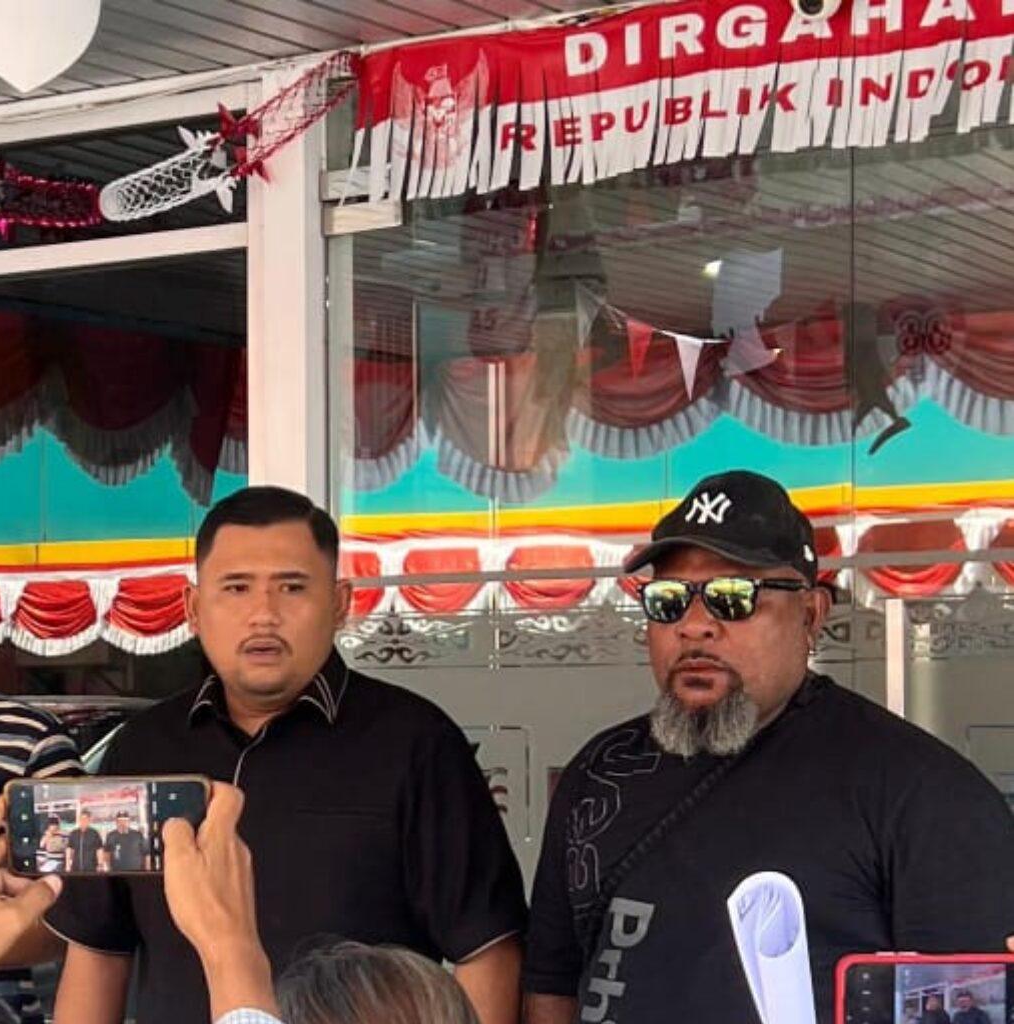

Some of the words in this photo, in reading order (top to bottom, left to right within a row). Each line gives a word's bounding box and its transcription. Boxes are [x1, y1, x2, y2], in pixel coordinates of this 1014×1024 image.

[565, 0, 1014, 77] DIRGAHA
[500, 82, 797, 151] REPUBLIK
[685, 491, 732, 524] NY
